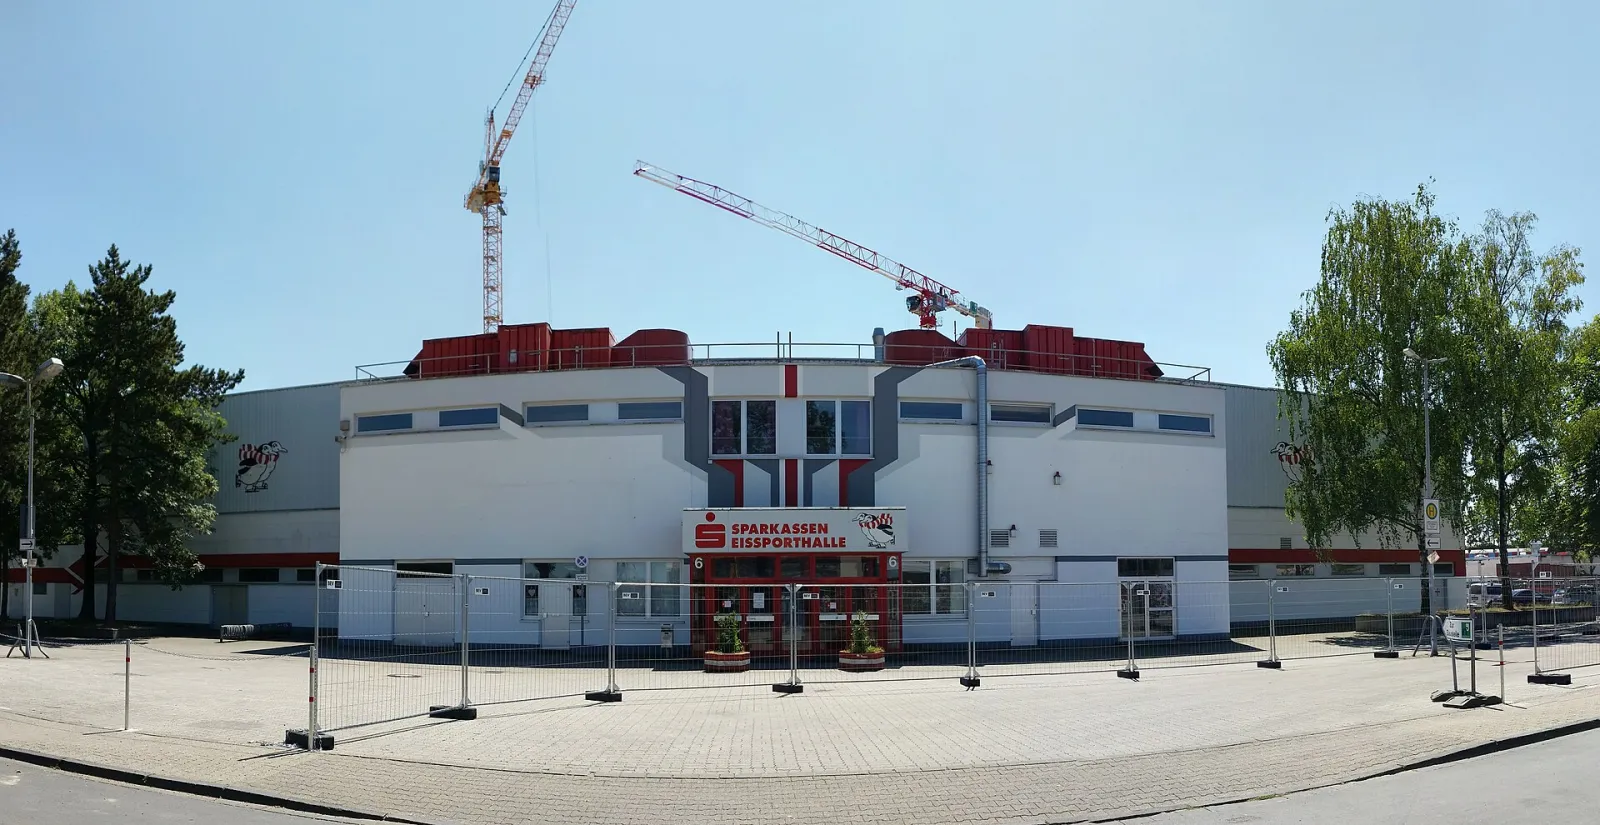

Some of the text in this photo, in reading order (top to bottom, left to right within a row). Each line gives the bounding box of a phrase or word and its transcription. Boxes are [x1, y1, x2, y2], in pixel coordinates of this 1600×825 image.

[731, 523, 829, 535] SPARKASSEN
[731, 537, 847, 549] EISSPORTHALLE
[694, 557, 704, 569] 6
[888, 556, 898, 568] 6
